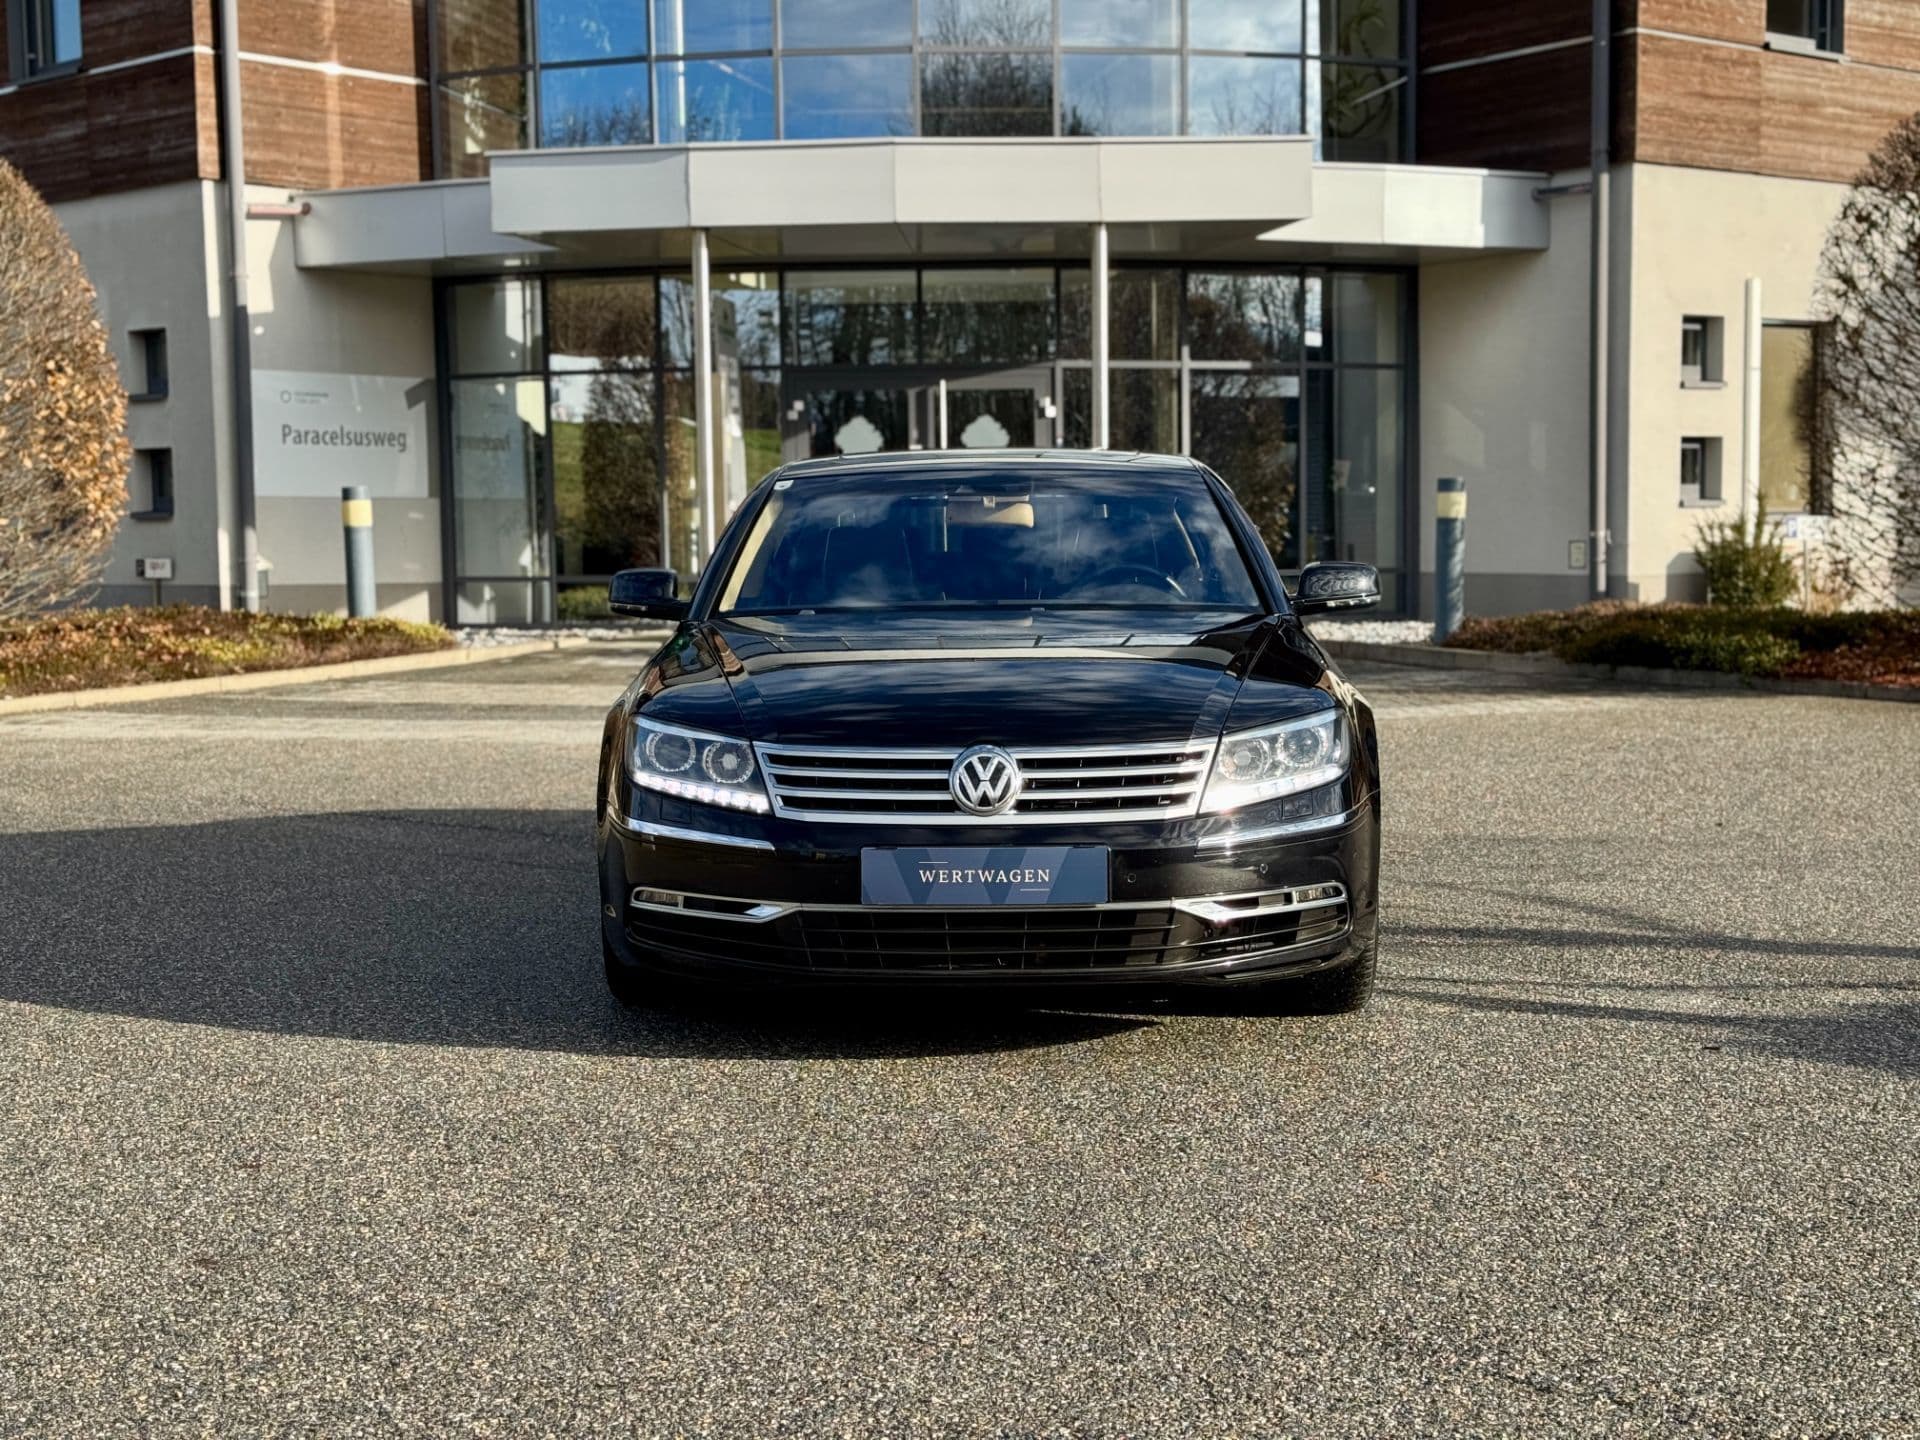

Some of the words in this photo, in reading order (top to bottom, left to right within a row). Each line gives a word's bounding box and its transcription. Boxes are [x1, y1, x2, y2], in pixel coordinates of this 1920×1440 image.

[281, 423, 407, 453] Paracelsusweg
[955, 753, 1017, 810] VW
[918, 869, 1050, 884] WERTWAGEN
